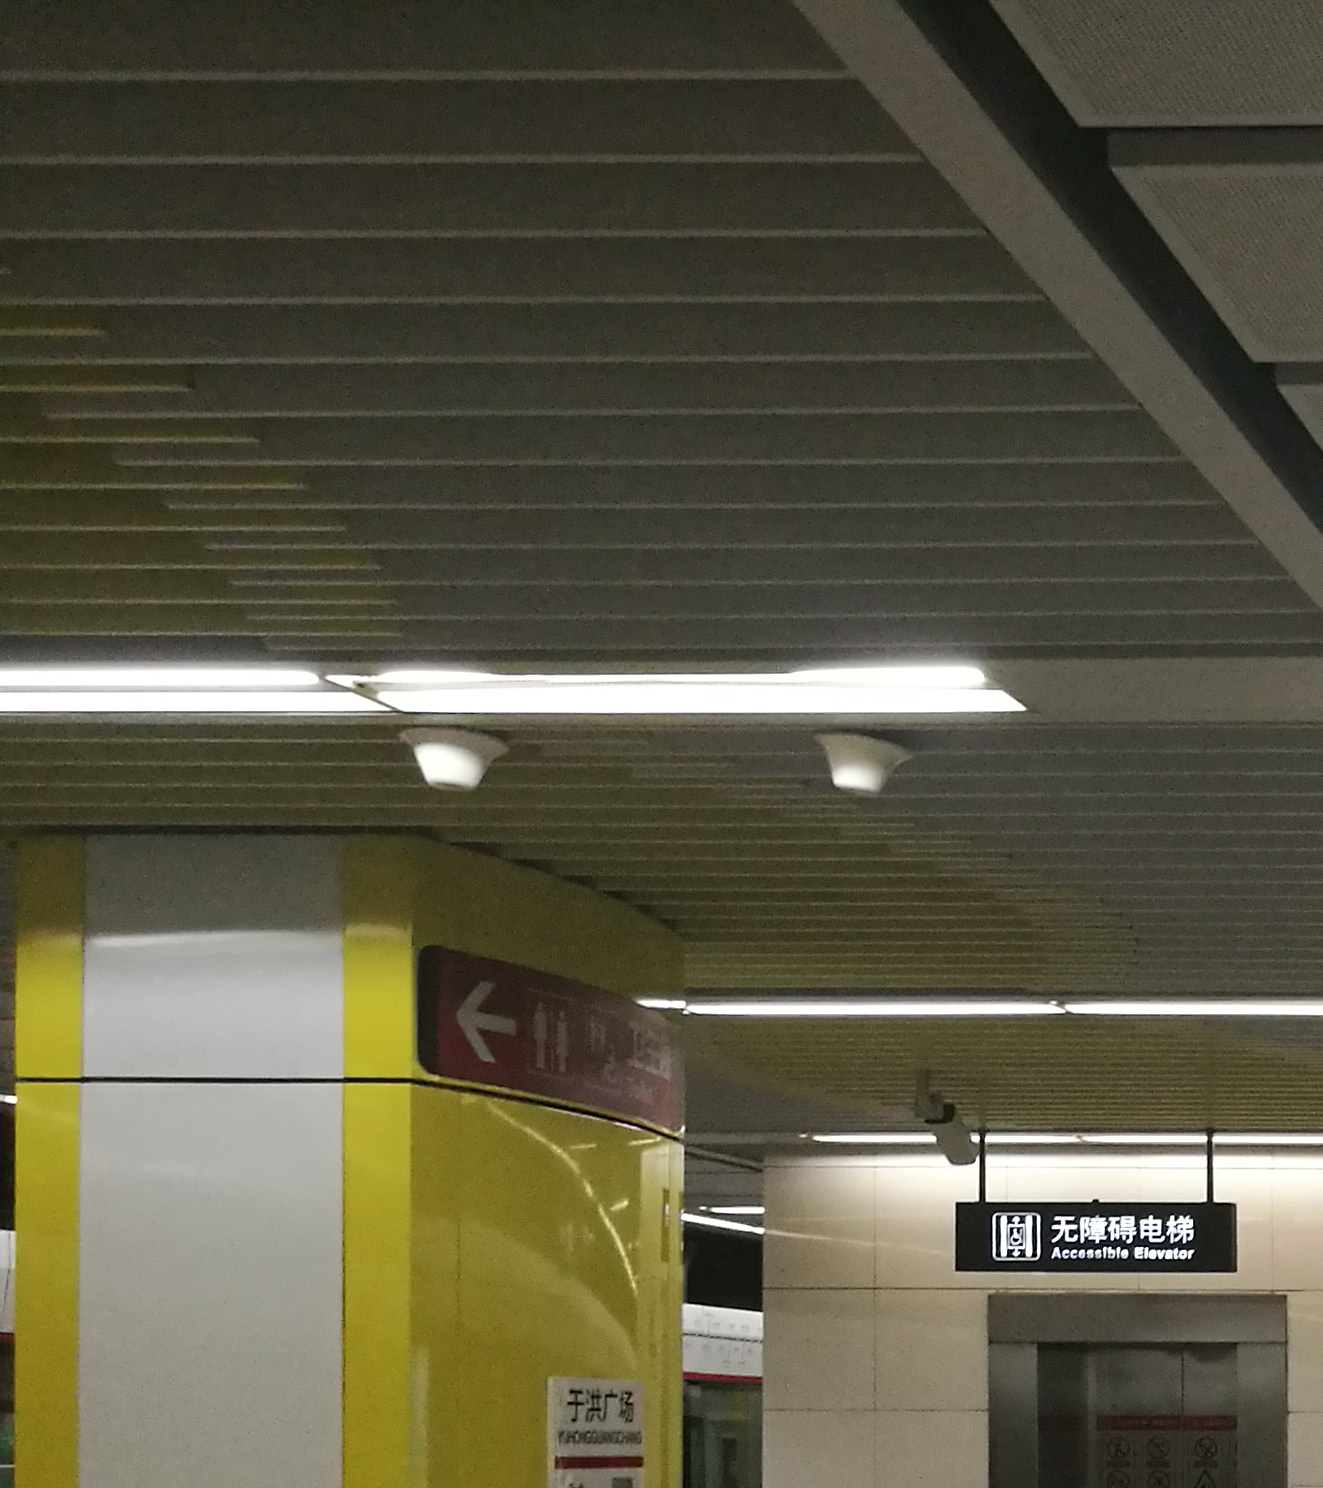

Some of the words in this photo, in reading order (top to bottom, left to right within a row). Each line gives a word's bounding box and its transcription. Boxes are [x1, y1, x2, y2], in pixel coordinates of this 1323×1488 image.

[1051, 1214, 1195, 1244] 无障碍电梯
[1051, 1246, 1129, 1260] Accessible
[1133, 1246, 1195, 1260] Elevator
[567, 1388, 635, 1423] 于洪广场
